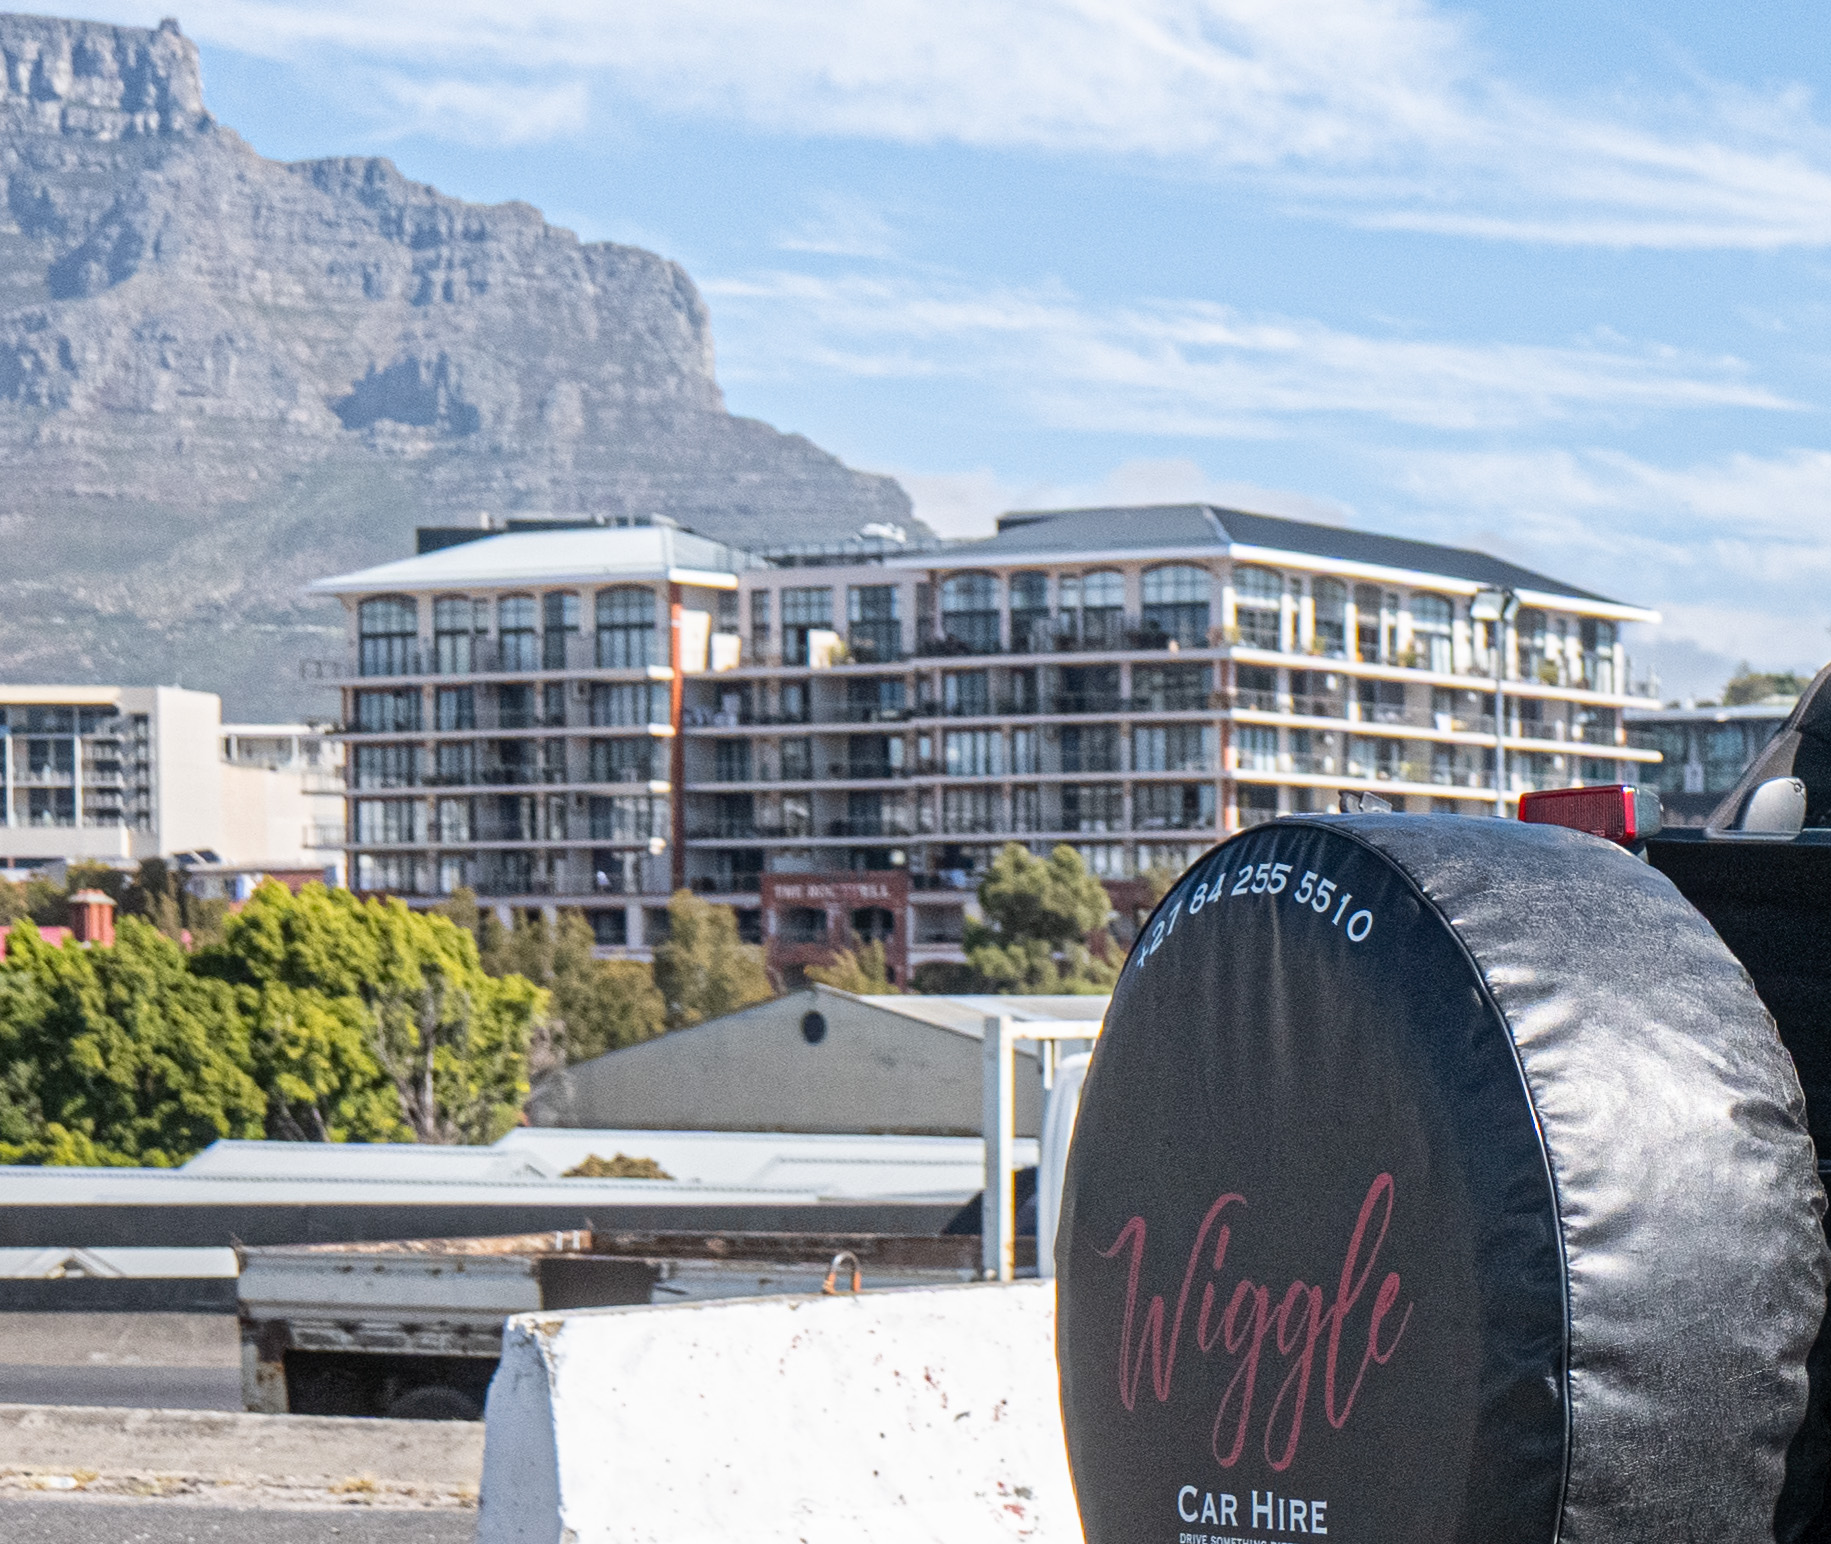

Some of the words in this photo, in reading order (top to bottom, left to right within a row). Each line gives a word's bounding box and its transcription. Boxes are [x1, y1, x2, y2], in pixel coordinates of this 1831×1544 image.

[1137, 901, 1183, 968] +27
[1189, 873, 1227, 915] 84
[1230, 862, 1293, 896] 255
[1294, 870, 1374, 943] 5510
[1099, 1172, 1413, 1471] Wiggle
